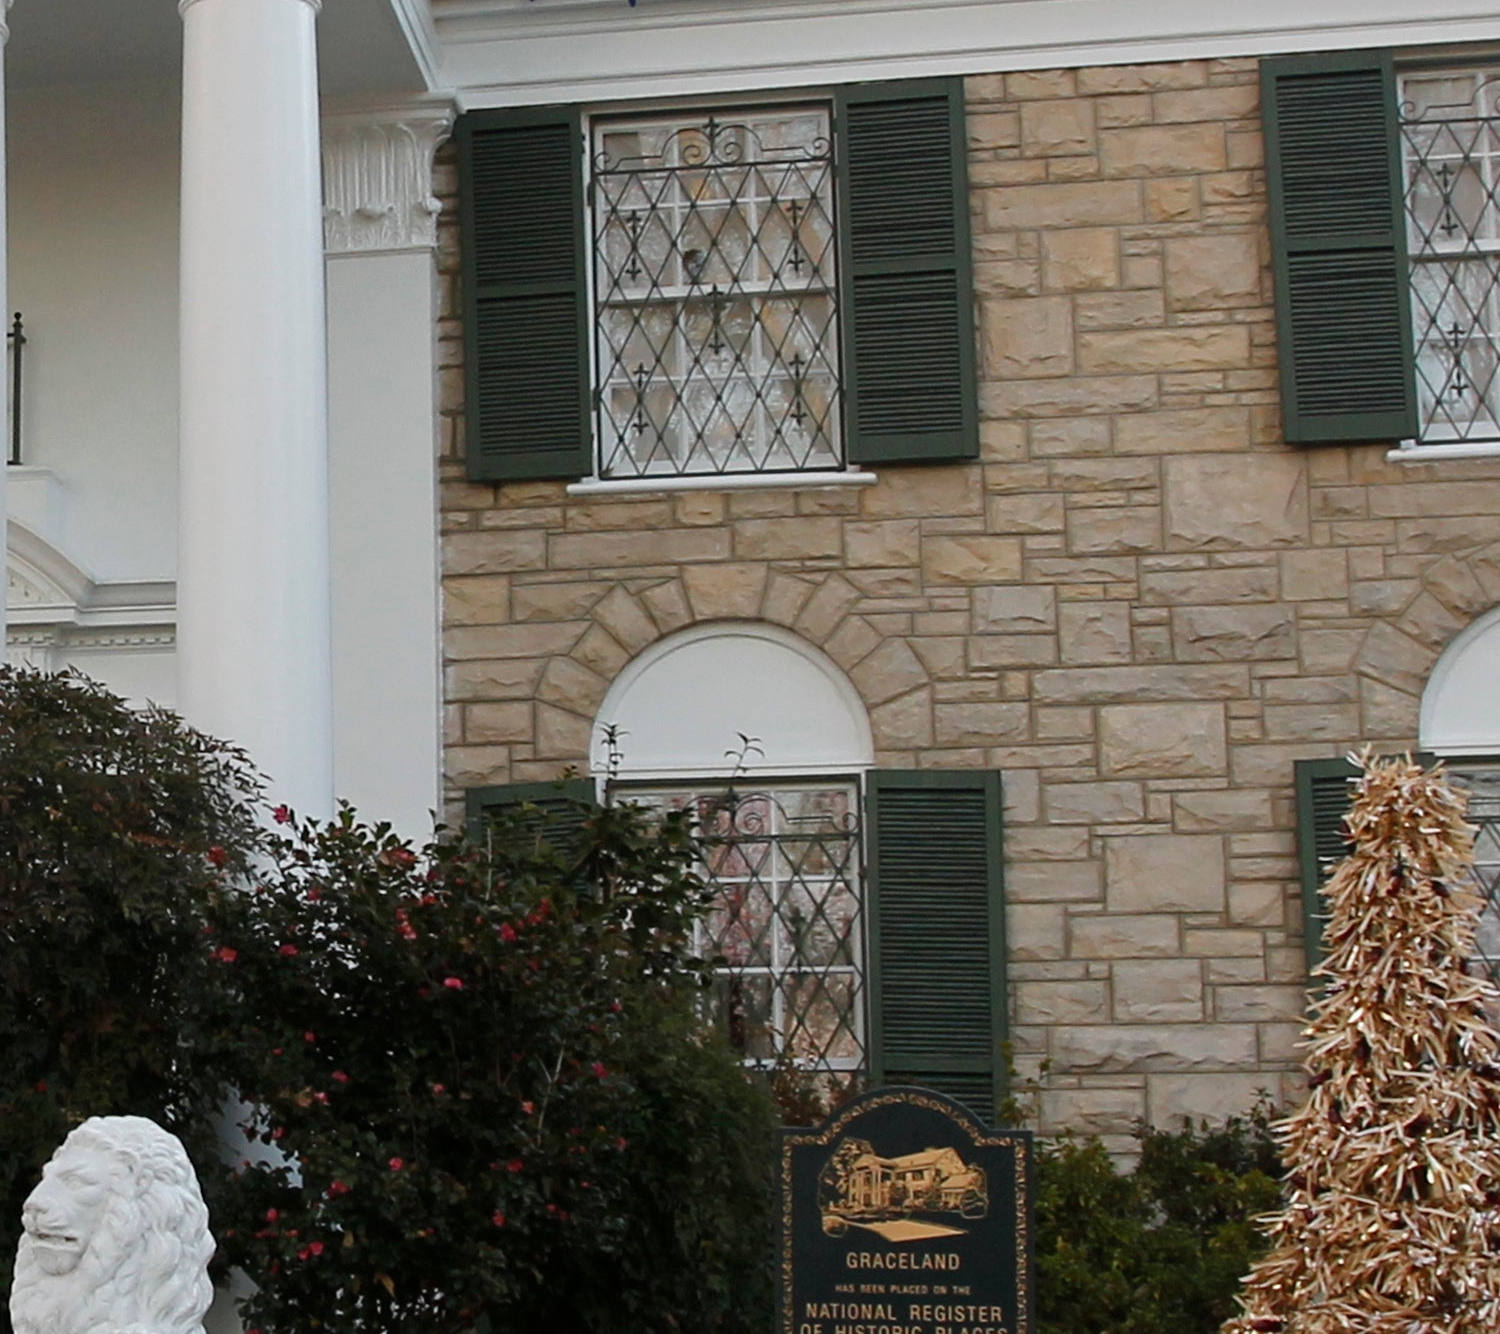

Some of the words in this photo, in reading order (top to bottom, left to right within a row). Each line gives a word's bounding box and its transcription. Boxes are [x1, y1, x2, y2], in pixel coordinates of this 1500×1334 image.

[846, 1252, 960, 1270] GRACELAND
[835, 1284, 855, 1293] HAS
[860, 1284, 885, 1294] BEEN
[890, 1285, 928, 1295] PLACED
[933, 1286, 947, 1295] ON
[952, 1286, 971, 1296] THE
[806, 1303, 897, 1321] NATIONAL
[910, 1305, 1002, 1322] REGISTER
